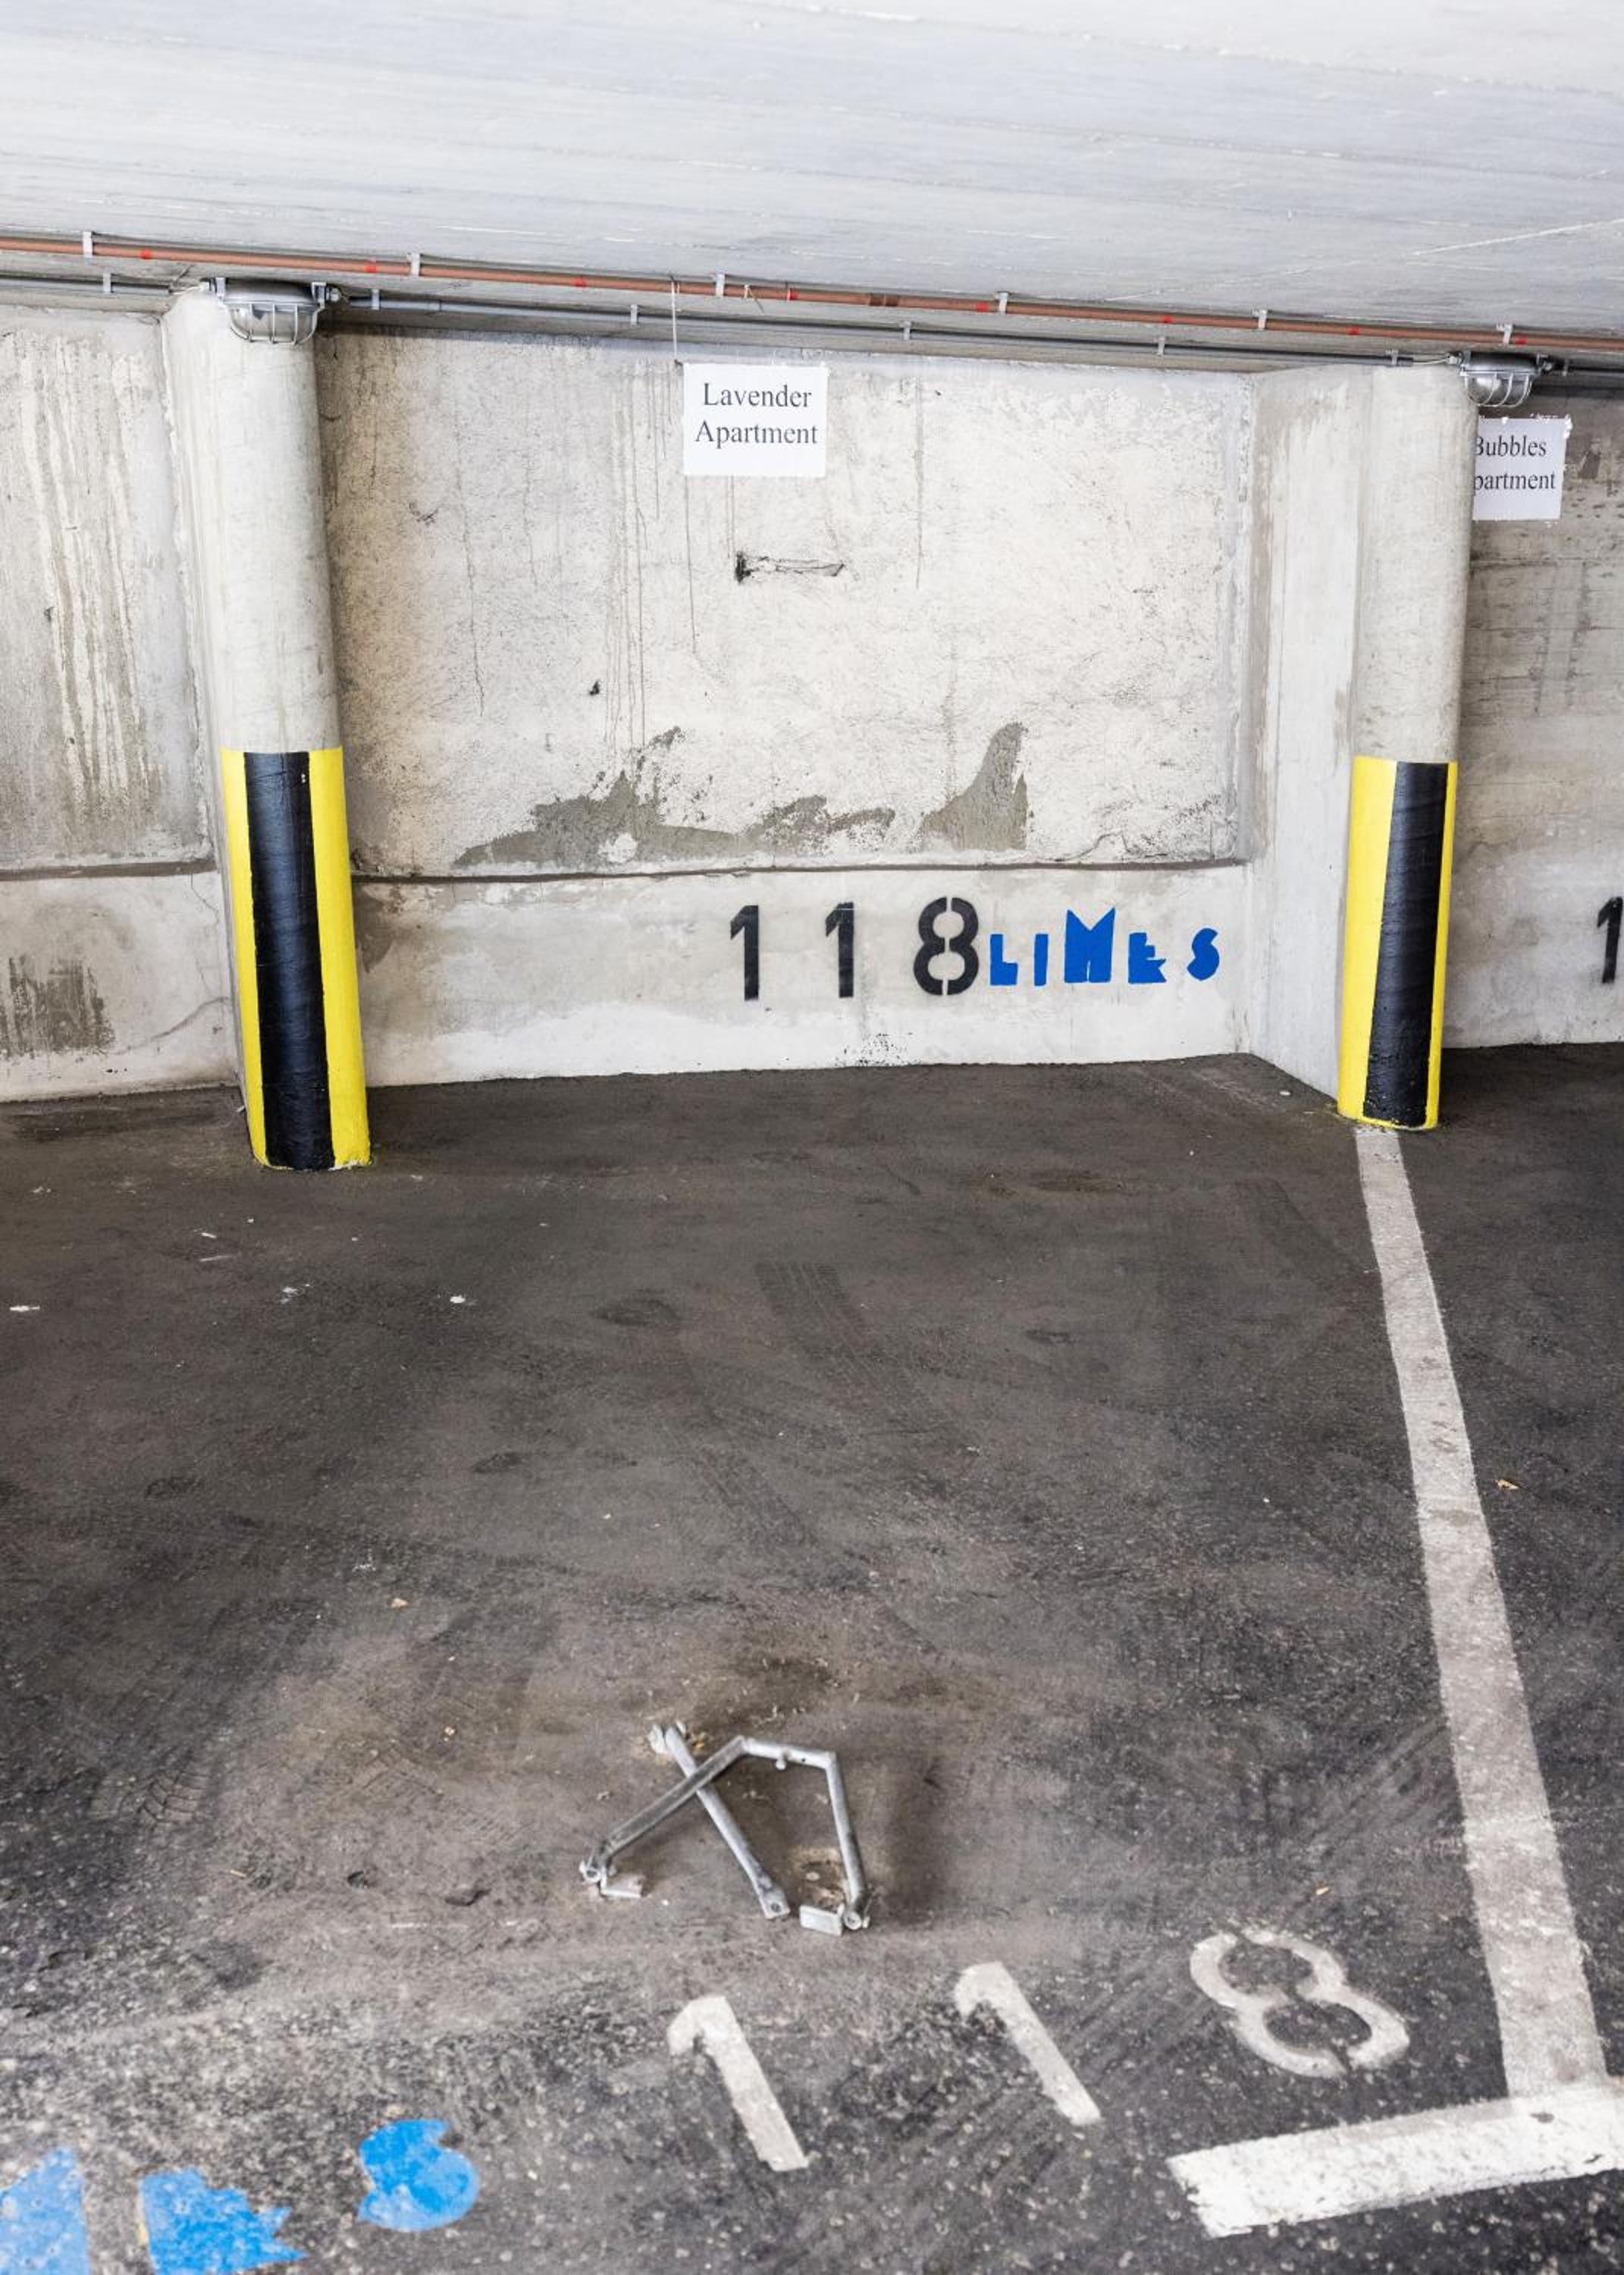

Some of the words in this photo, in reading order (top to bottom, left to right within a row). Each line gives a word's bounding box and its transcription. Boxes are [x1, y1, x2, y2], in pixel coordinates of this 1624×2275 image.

[704, 382, 812, 407] Lavender
[695, 421, 818, 449] Apartment
[1475, 435, 1547, 457] Bubbles
[1473, 472, 1556, 496] partment
